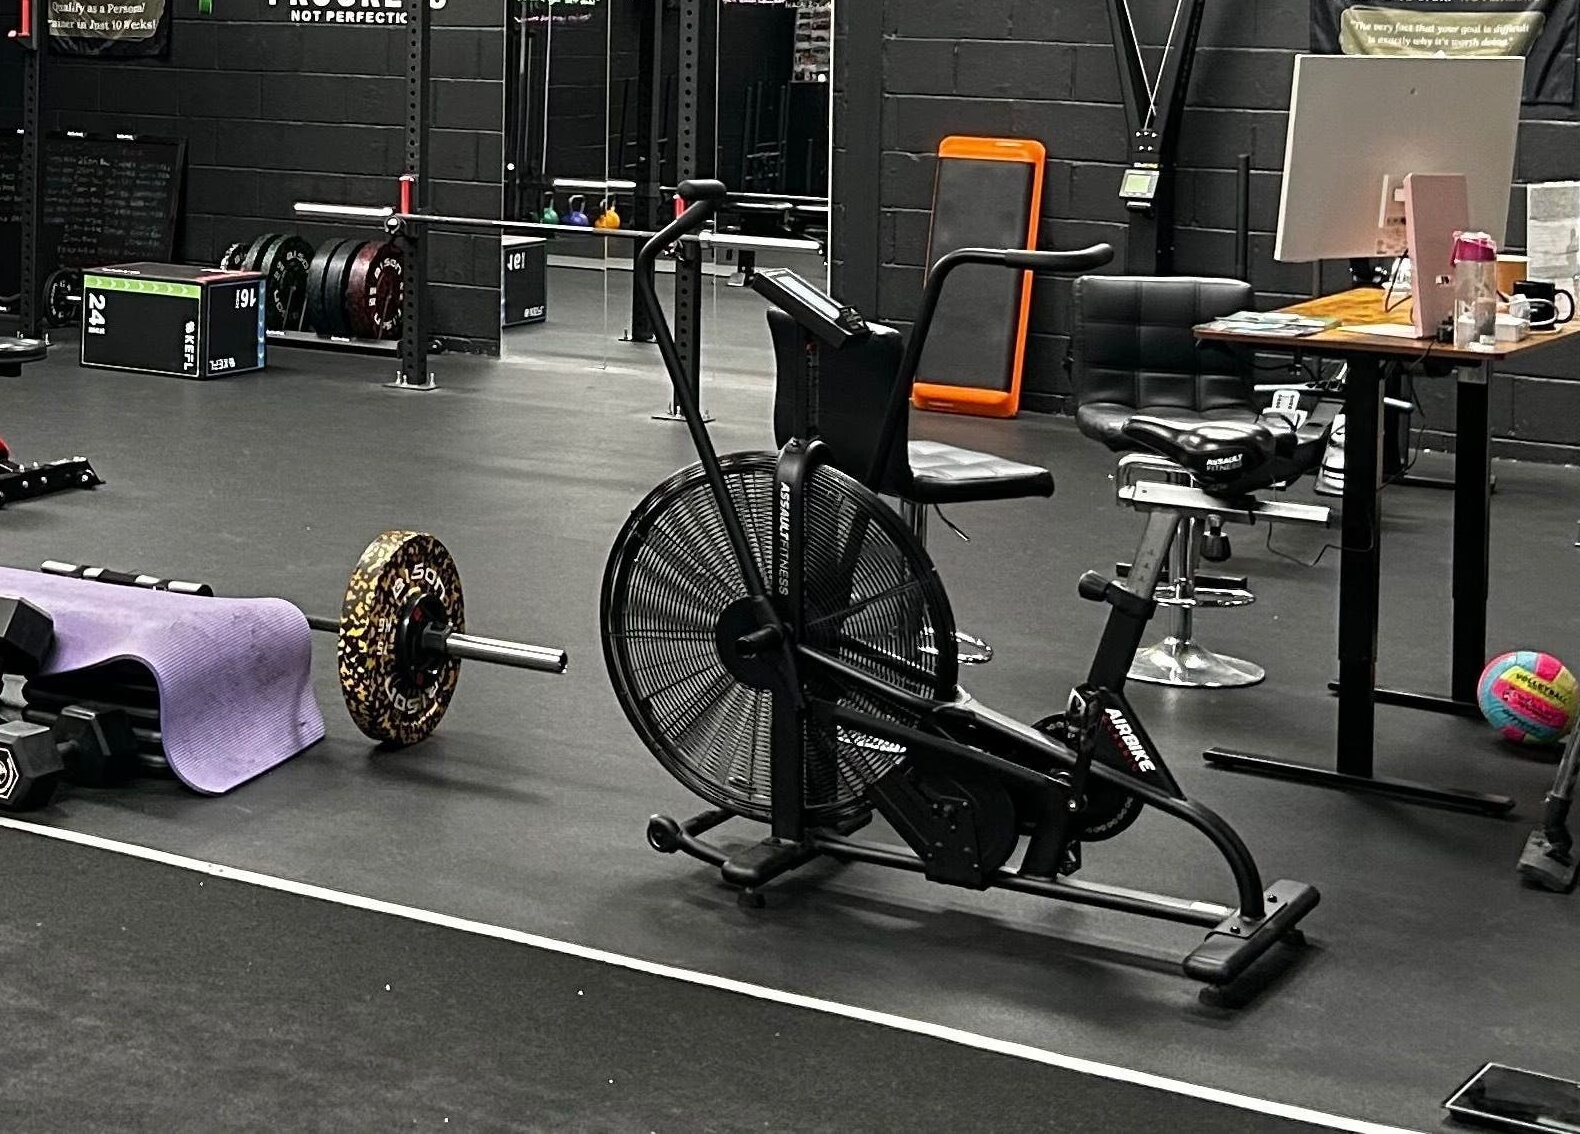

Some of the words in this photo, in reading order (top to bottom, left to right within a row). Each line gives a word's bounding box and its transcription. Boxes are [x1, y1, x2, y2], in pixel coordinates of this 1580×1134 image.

[52, 2, 85, 15] Qualify
[87, 4, 97, 13] as
[99, 5, 105, 14] a
[107, 2, 146, 14] Personal
[290, 9, 321, 22] NOT
[326, 10, 408, 24] PERFECTIO
[89, 19, 109, 30] Just
[111, 20, 122, 30] 10
[1437, 24, 1459, 34] your
[88, 292, 106, 326] 24
[1516, 673, 1567, 704] VOLLEYBALL
[1104, 708, 1156, 772] AIRBIKE
